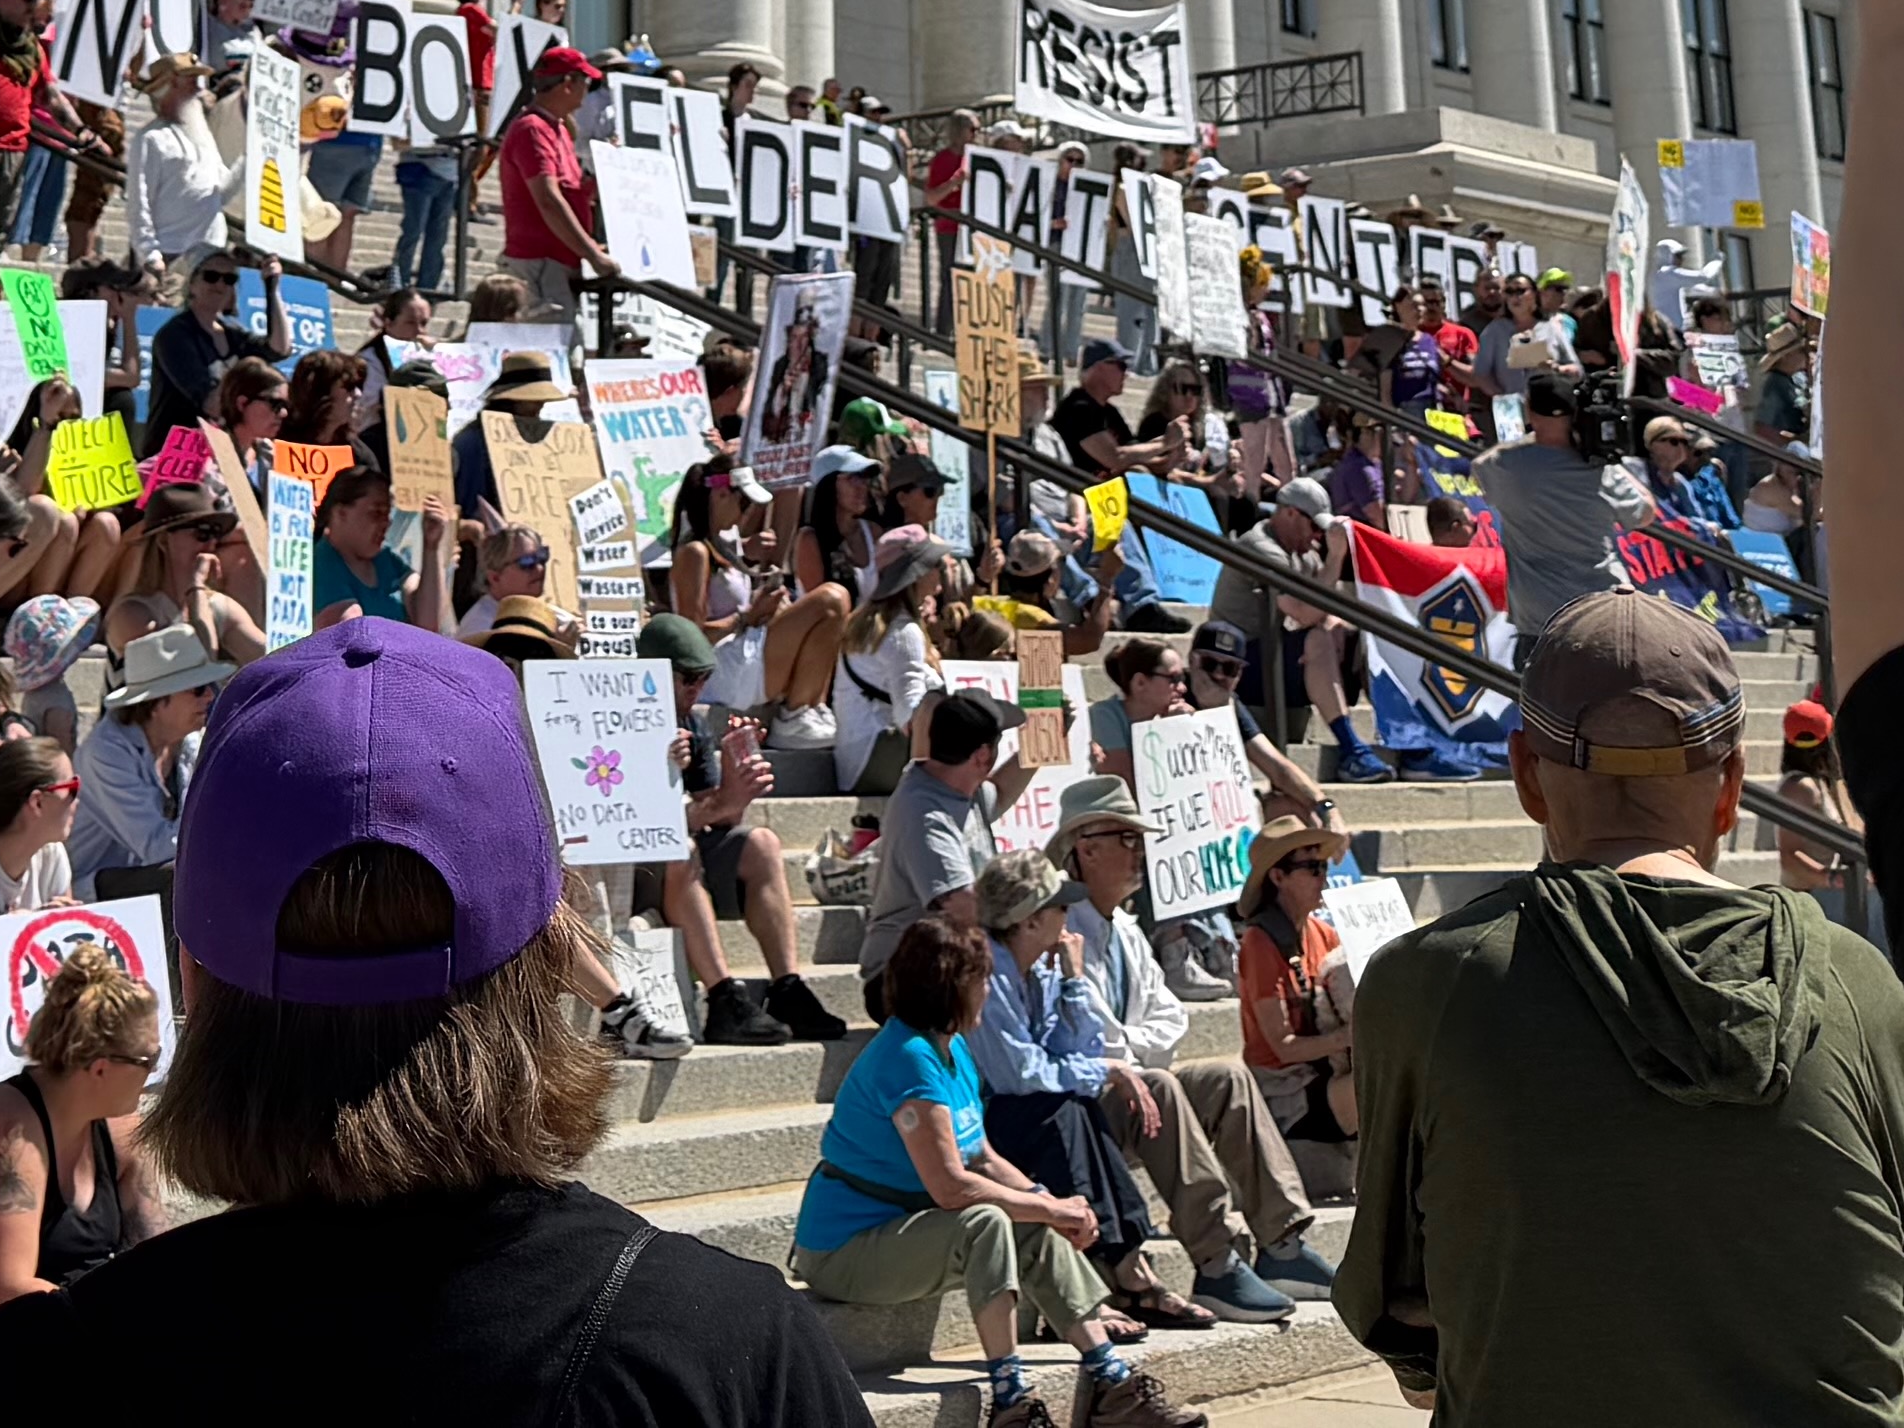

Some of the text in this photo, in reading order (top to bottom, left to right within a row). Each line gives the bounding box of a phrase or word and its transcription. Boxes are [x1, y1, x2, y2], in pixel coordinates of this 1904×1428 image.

[620, 83, 907, 242] ELDER
[956, 275, 1015, 333] FLUSH
[250, 311, 326, 344] OT OF
[967, 333, 1011, 377] THE
[659, 369, 703, 396] OUR
[959, 375, 1018, 428] SHARK
[52, 414, 114, 454] OTECT
[288, 446, 329, 475] NO
[273, 540, 308, 571] LIFE
[582, 546, 627, 564] Water
[280, 573, 305, 598] NOT
[579, 578, 641, 596] Wasters
[272, 596, 307, 630] DATA
[591, 616, 605, 629] to
[548, 671, 636, 703] I WANT
[592, 708, 666, 740] FLOWERS
[558, 802, 638, 834] NO DATA
[1000, 786, 1055, 829] HE
[1151, 779, 1250, 844] IF WE KILL
[617, 827, 681, 851] CENTER
[1155, 835, 1243, 905] OUR HOME
